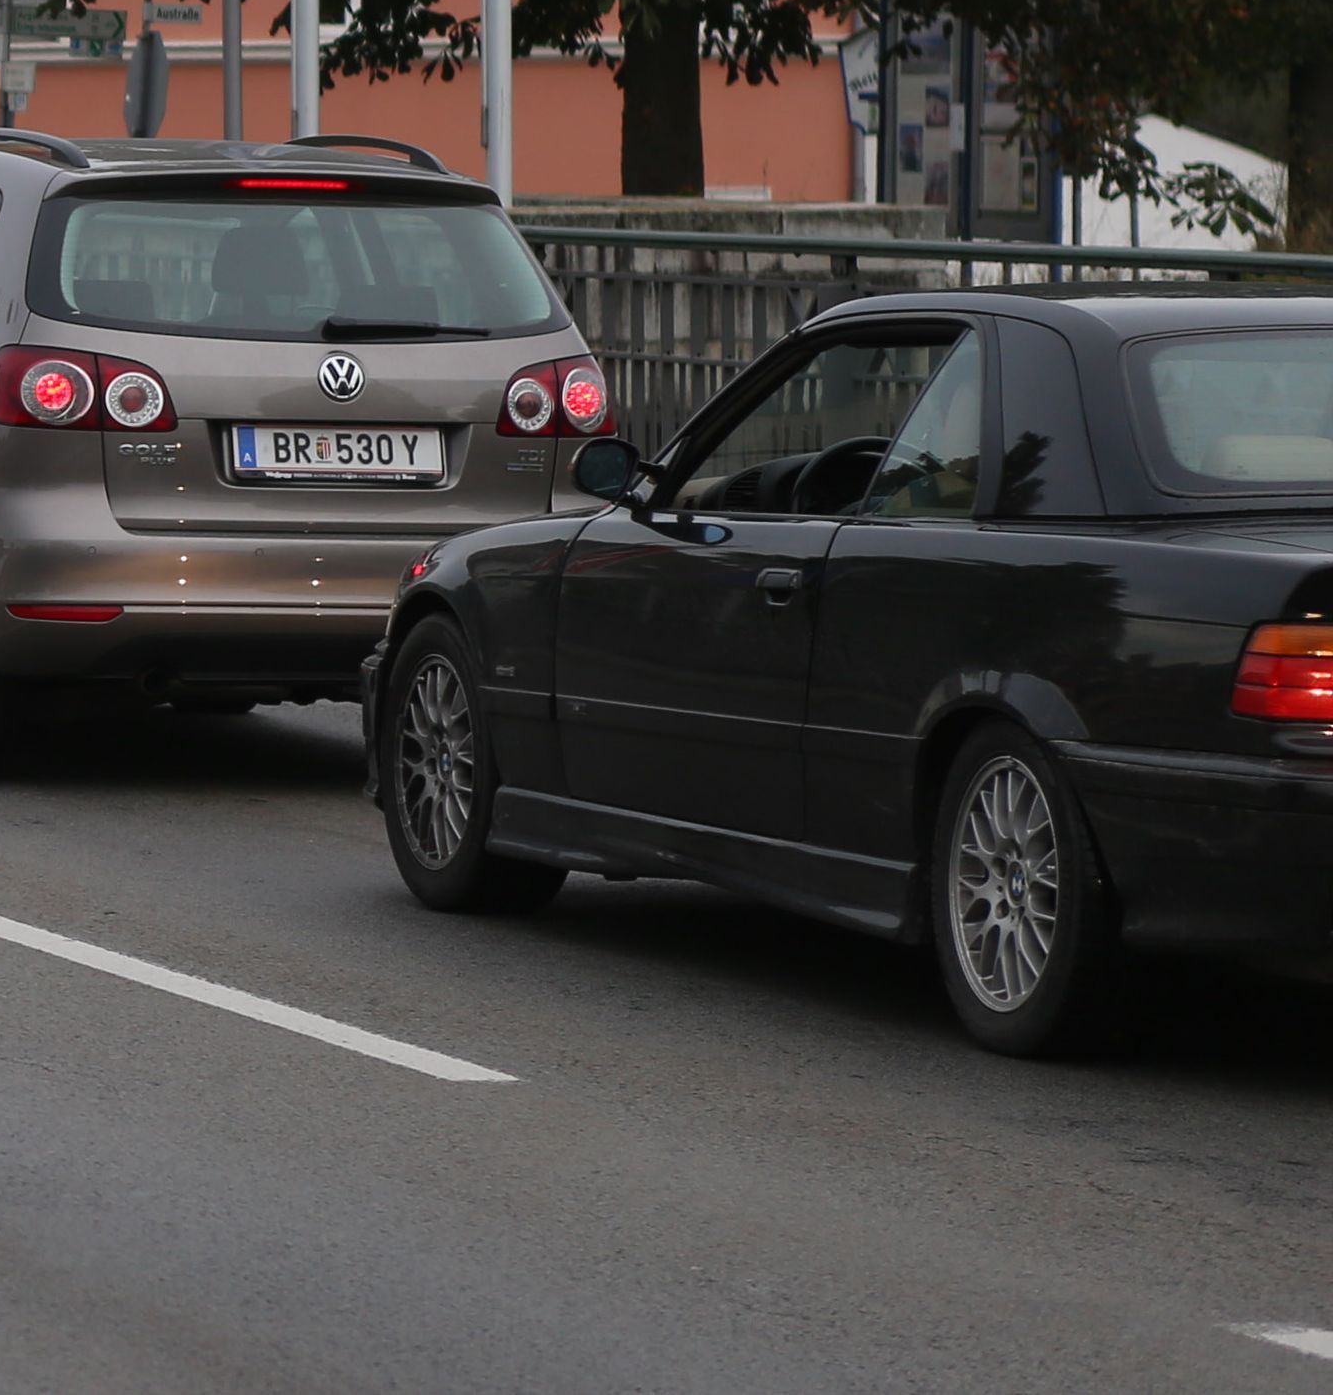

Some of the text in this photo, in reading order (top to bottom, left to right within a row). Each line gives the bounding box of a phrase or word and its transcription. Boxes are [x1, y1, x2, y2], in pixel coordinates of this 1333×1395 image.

[273, 432, 418, 466] BR 530 Y
